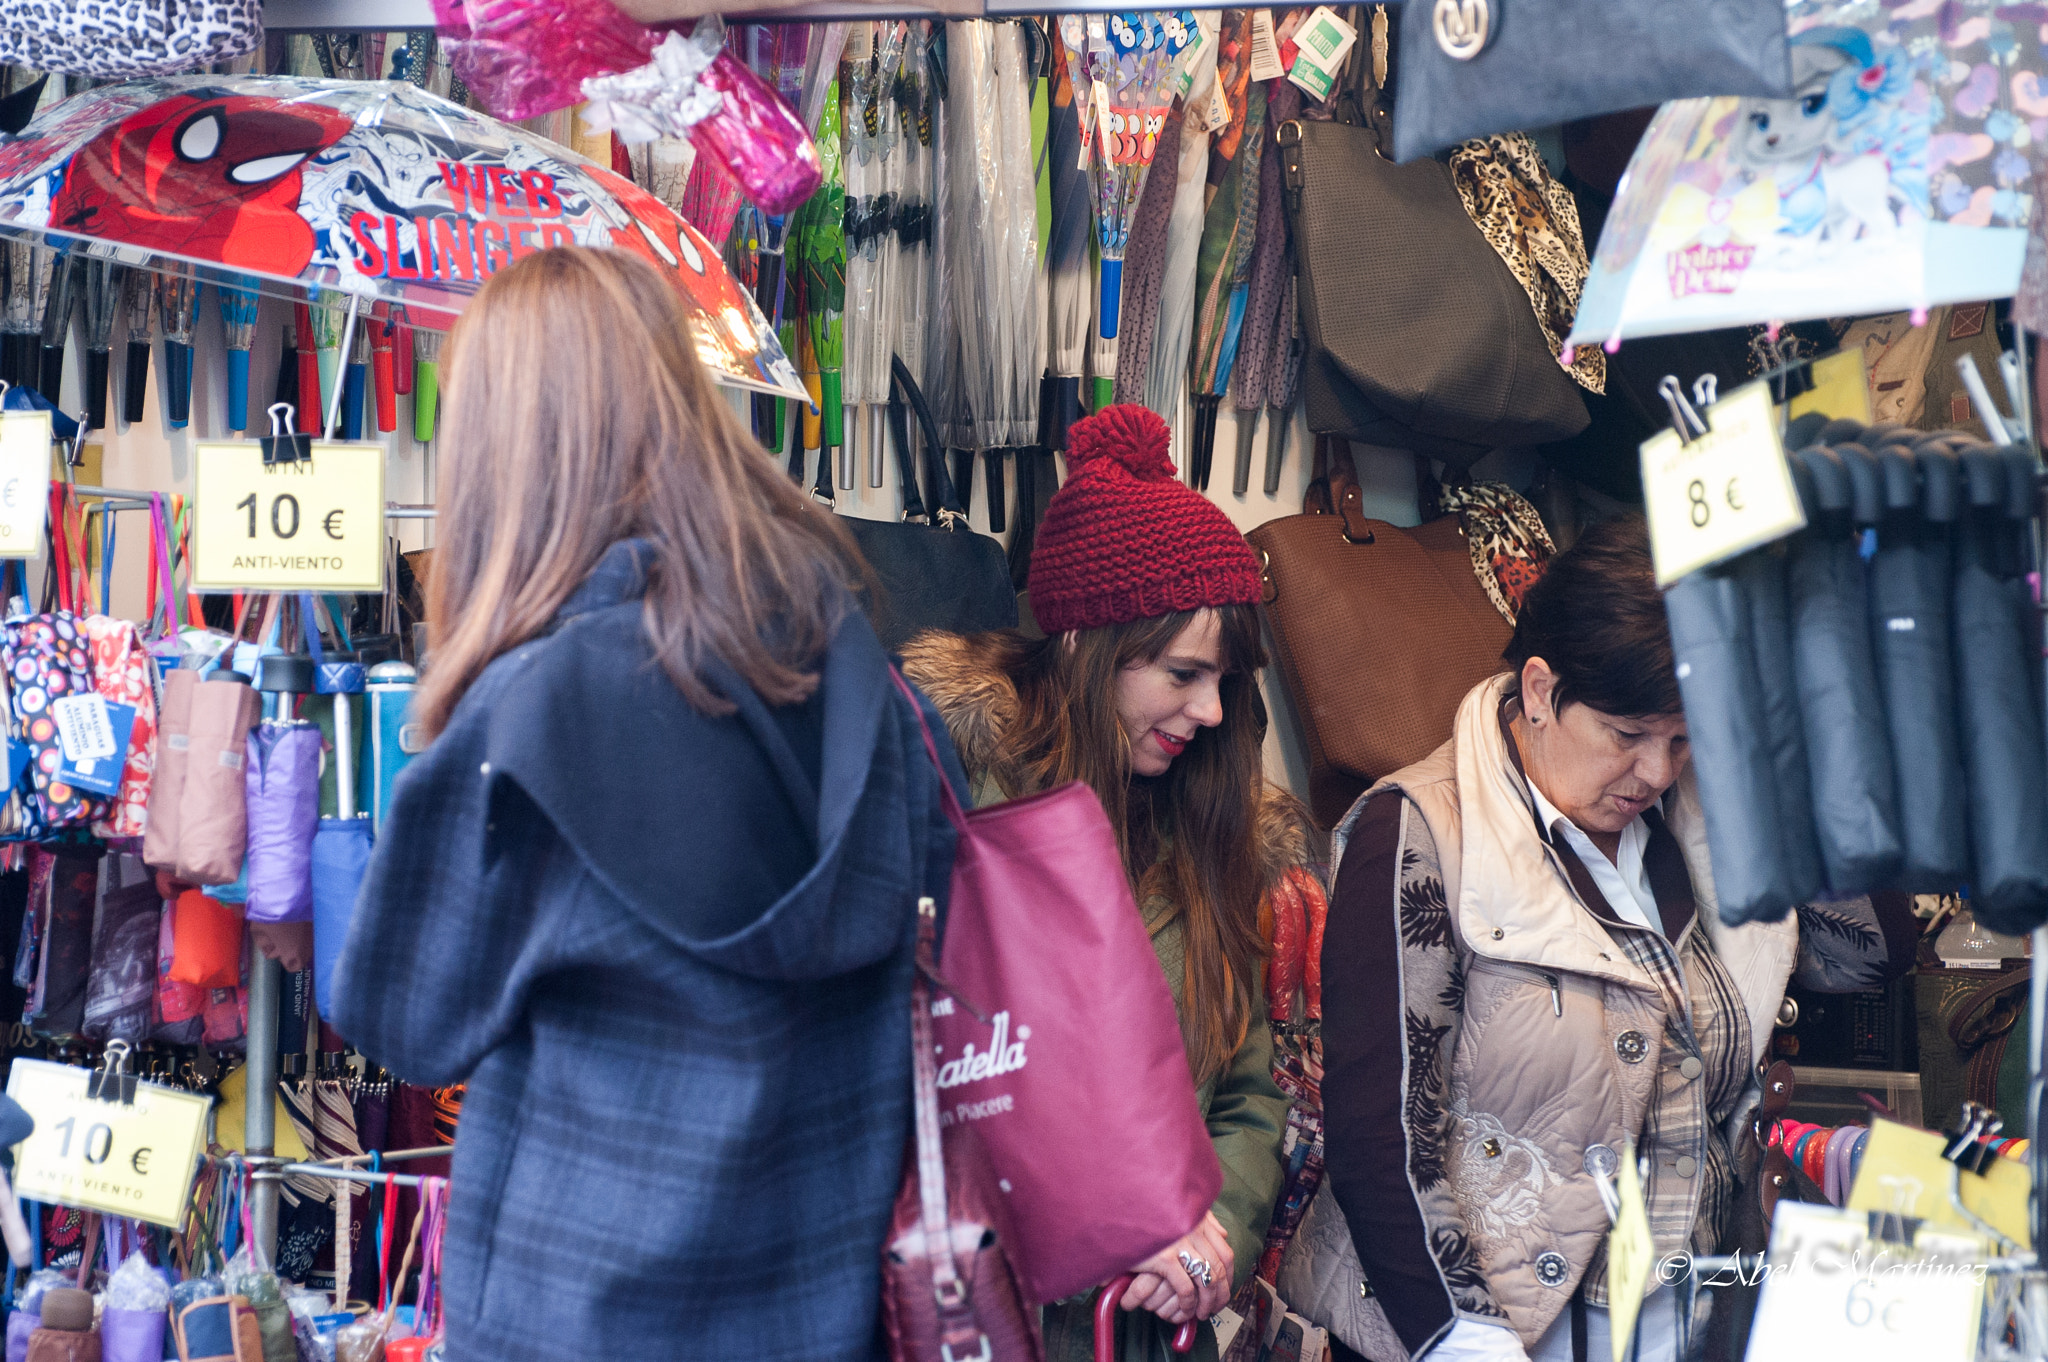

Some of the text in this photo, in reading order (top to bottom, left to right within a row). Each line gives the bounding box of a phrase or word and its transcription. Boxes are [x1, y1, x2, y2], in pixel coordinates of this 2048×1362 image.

[436, 161, 565, 219] WEB
[236, 492, 345, 540] 10 €
[1688, 476, 1746, 528] 8 €
[232, 555, 343, 570] ANTI-VIENTO
[88, 702, 105, 749] PARAGUAS
[956, 1093, 1014, 1123] Piacere
[54, 1116, 153, 1176] 10 €
[1845, 1278, 1877, 1327] 6
